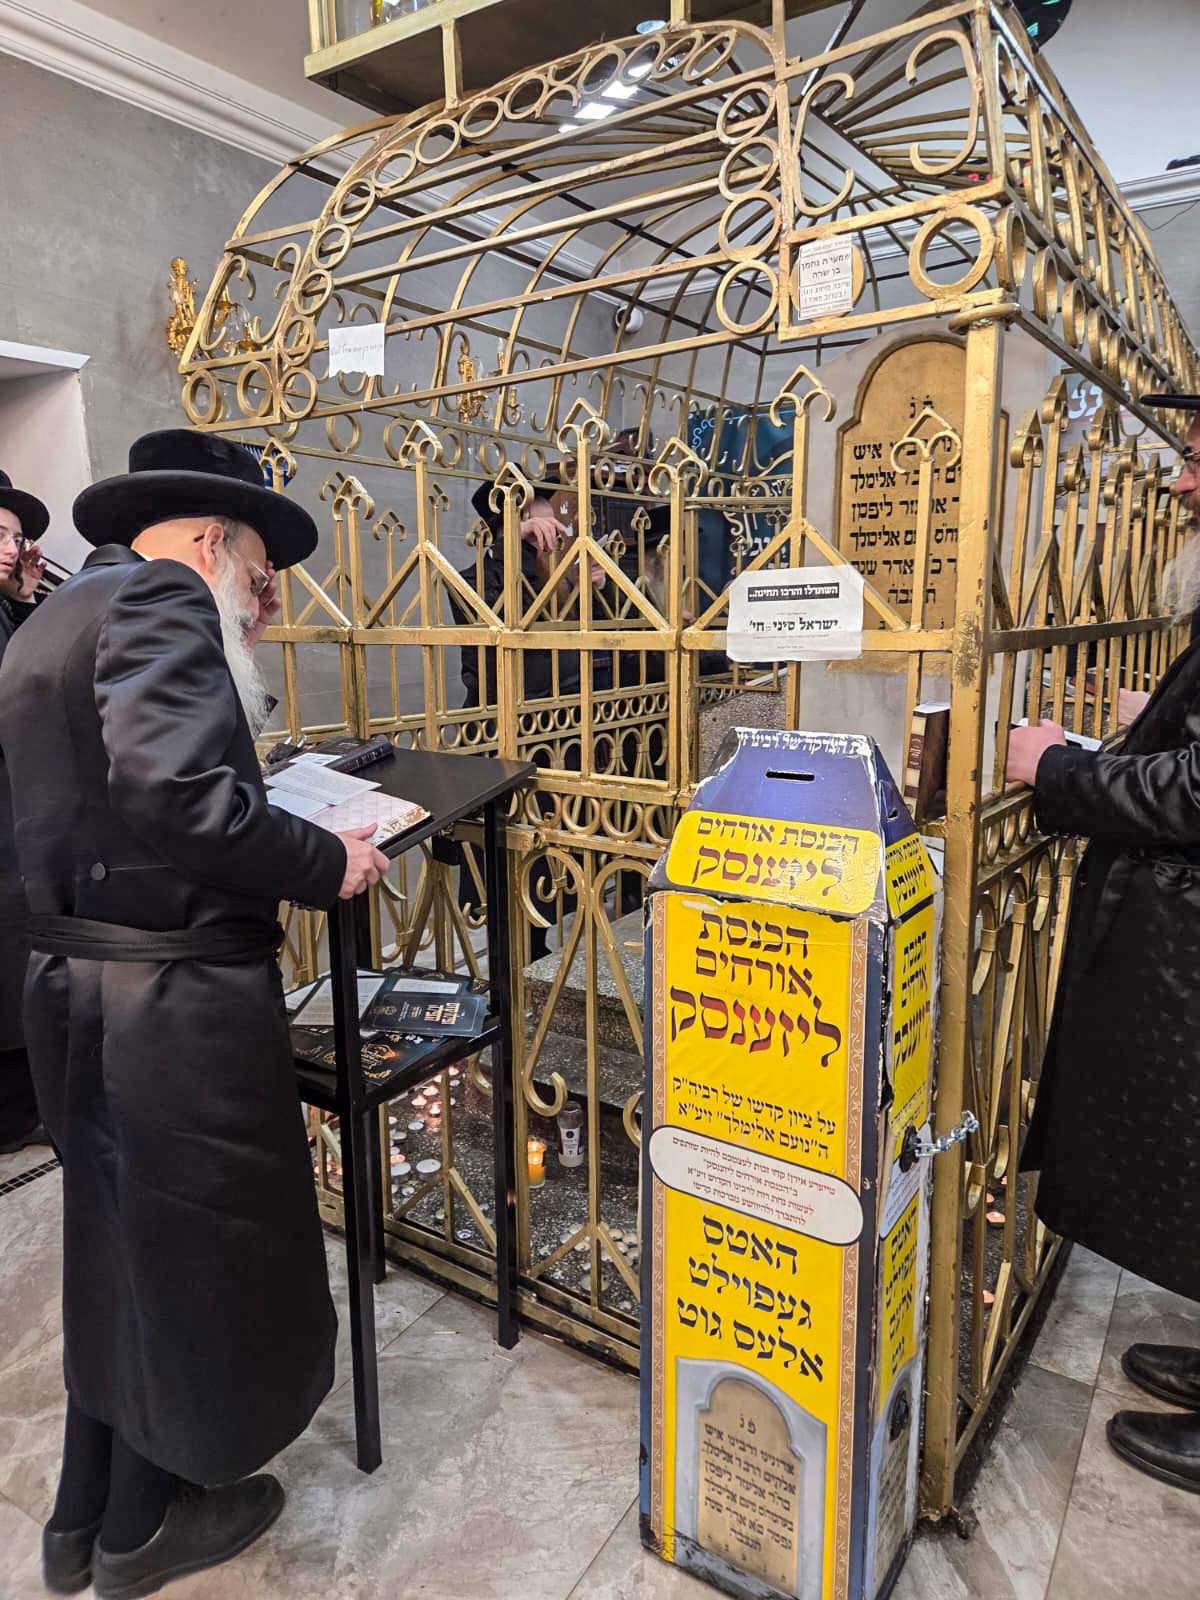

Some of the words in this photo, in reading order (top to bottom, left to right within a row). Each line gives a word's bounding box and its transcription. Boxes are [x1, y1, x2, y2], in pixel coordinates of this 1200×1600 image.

[853, 443, 883, 460] איש
[850, 466, 896, 491] אלימלך
[851, 493, 893, 522] ליפמן
[849, 524, 900, 552] אלימלך
[773, 620, 796, 632] סיני
[799, 617, 839, 631] ישראל
[697, 816, 776, 844] אורחים
[779, 827, 860, 856] הכנסת
[691, 845, 843, 897] ליזענסק
[699, 910, 810, 959] הכנסת
[695, 946, 813, 999] אורחים
[670, 984, 842, 1068] ליזענסק
[672, 1076, 719, 1102] רביה"ק
[722, 1084, 743, 1108] של
[678, 1101, 713, 1124] זיע"א
[747, 1097, 784, 1123] קדשו
[788, 1108, 813, 1129] ציון
[817, 1111, 836, 1136] על
[779, 1131, 829, 1160] ה"נועם
[702, 1214, 798, 1275] האטס
[688, 1252, 812, 1330] געפוילט
[677, 1296, 723, 1341] גוט
[733, 1319, 824, 1383] אלעס
